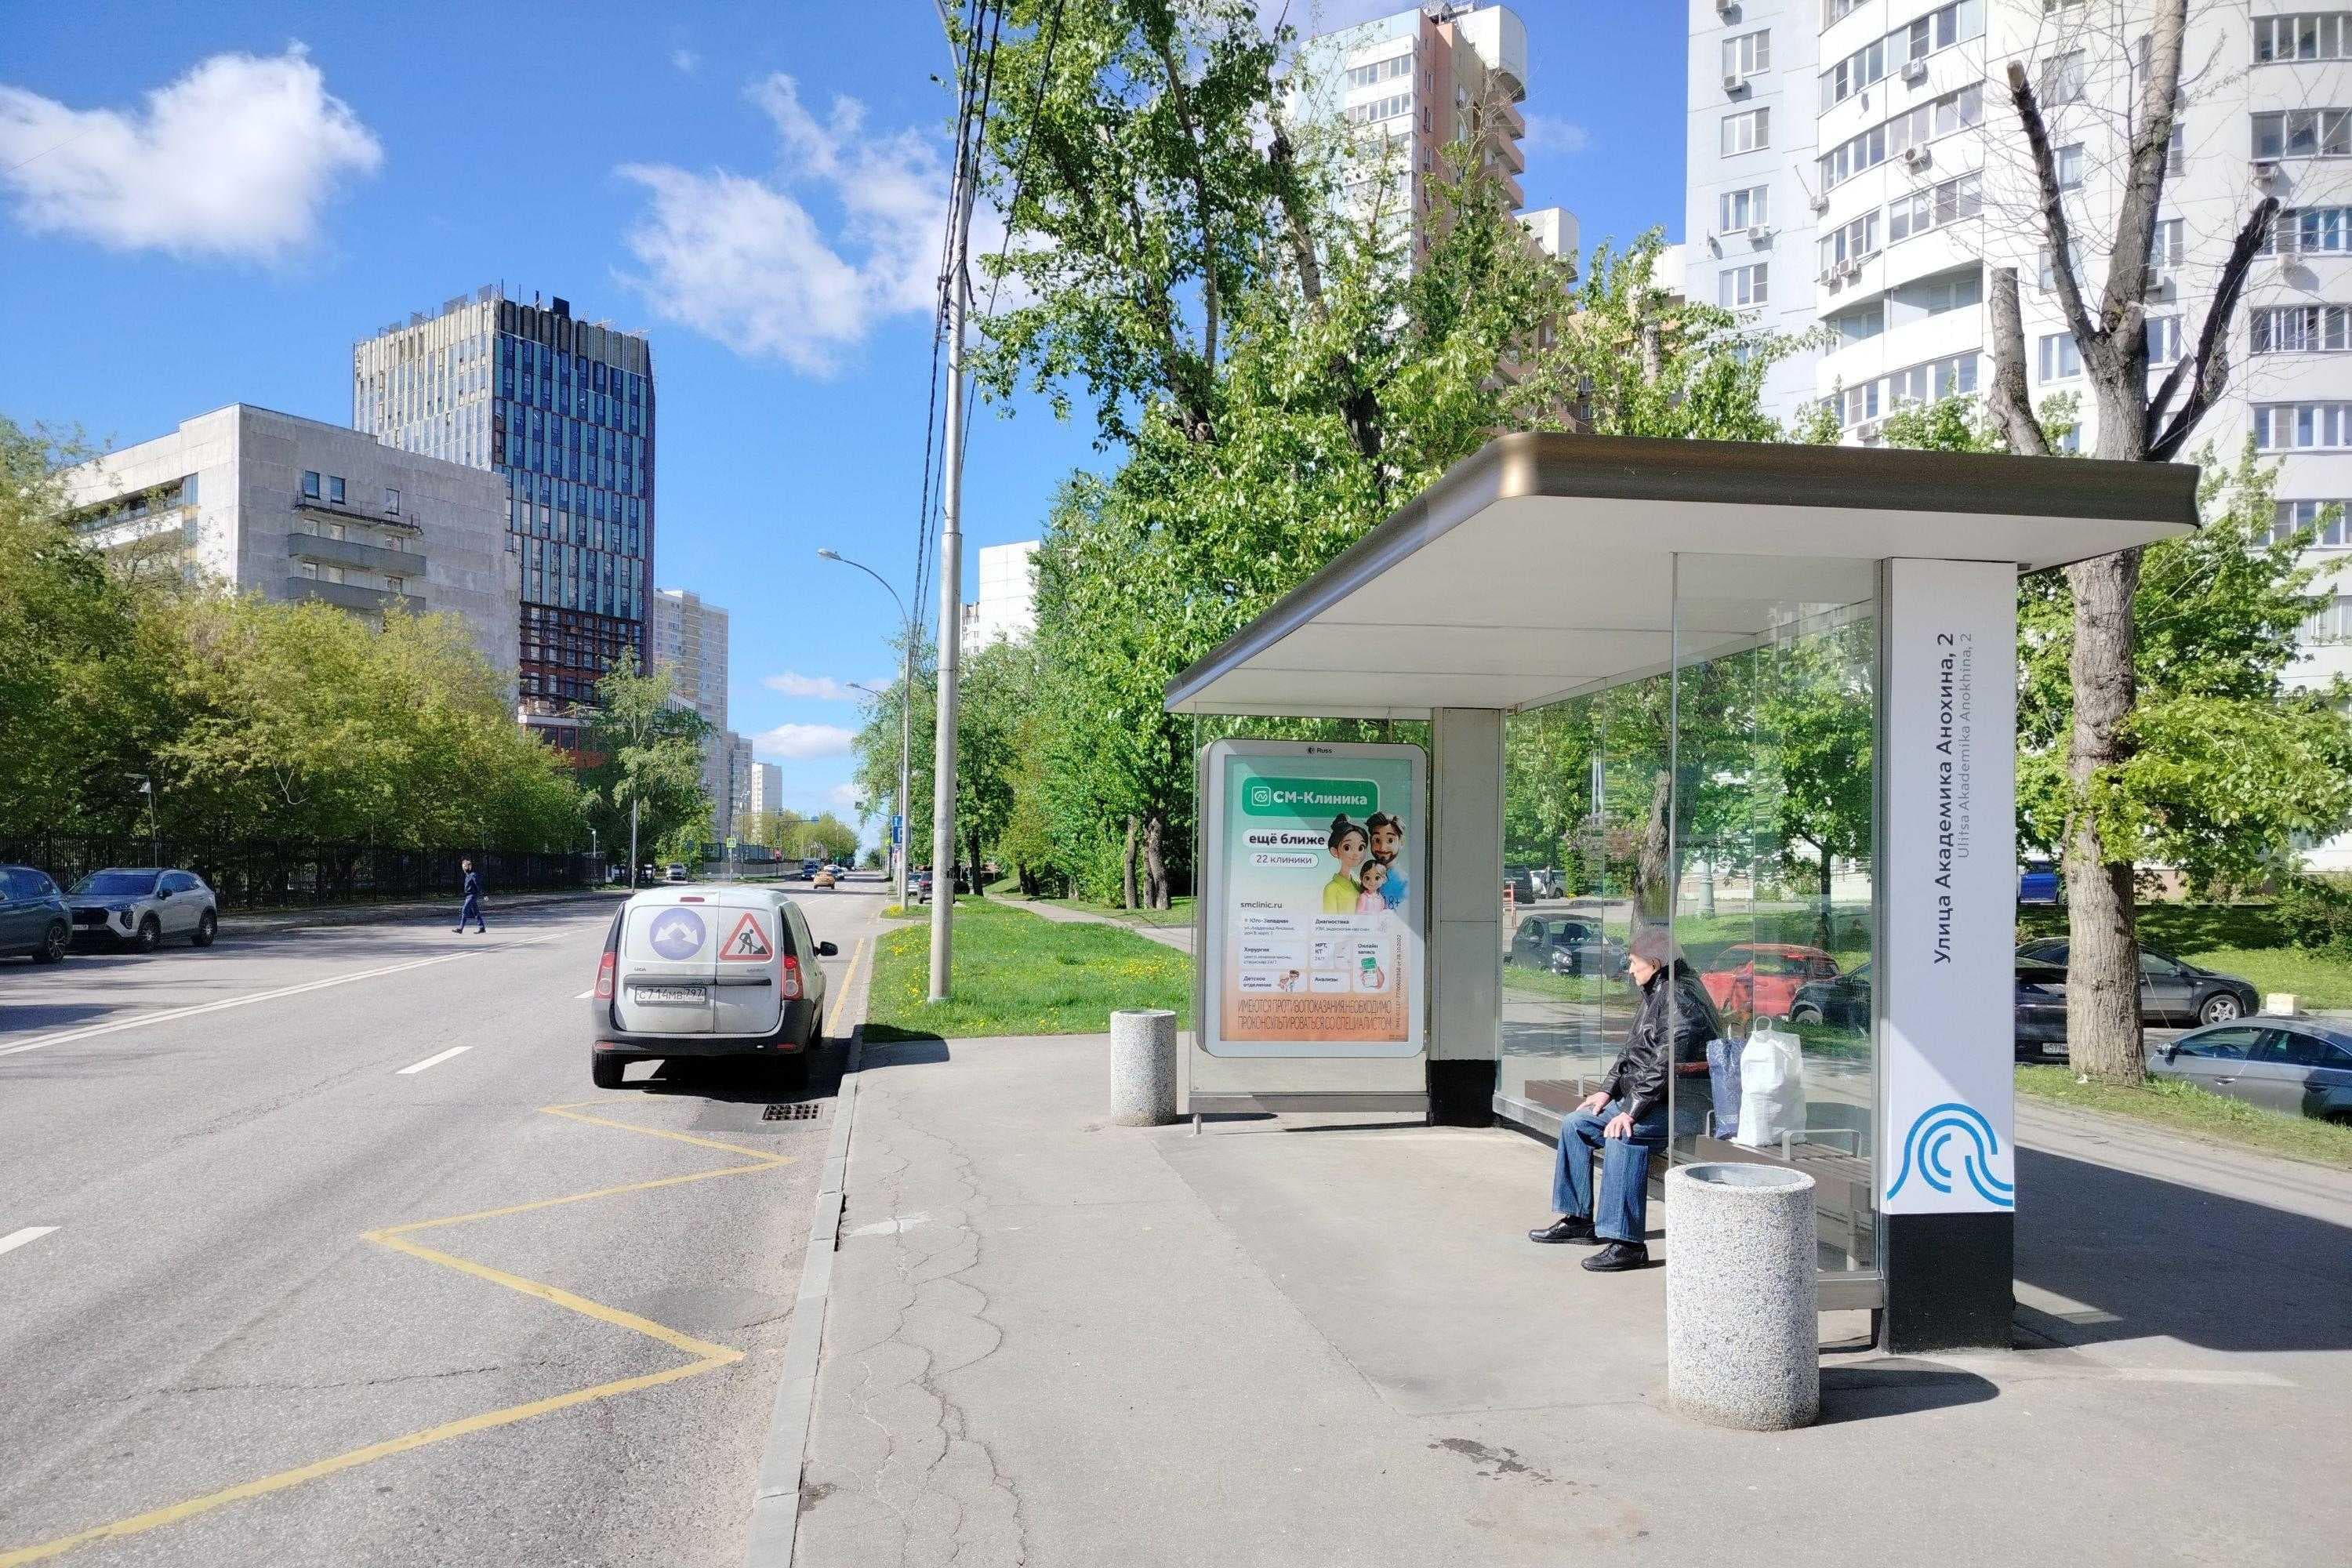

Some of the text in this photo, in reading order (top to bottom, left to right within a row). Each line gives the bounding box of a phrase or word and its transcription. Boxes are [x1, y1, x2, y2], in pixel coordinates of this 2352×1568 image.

[1958, 633, 1973, 858] Ulitsa Akademika Anokhina, 2
[1273, 790, 1368, 806] СМ-Клиника
[1934, 633, 1958, 964] Улица Академика Анохина, 2
[1249, 833, 1325, 846] ещё ближе
[1256, 855, 1269, 863] 22
